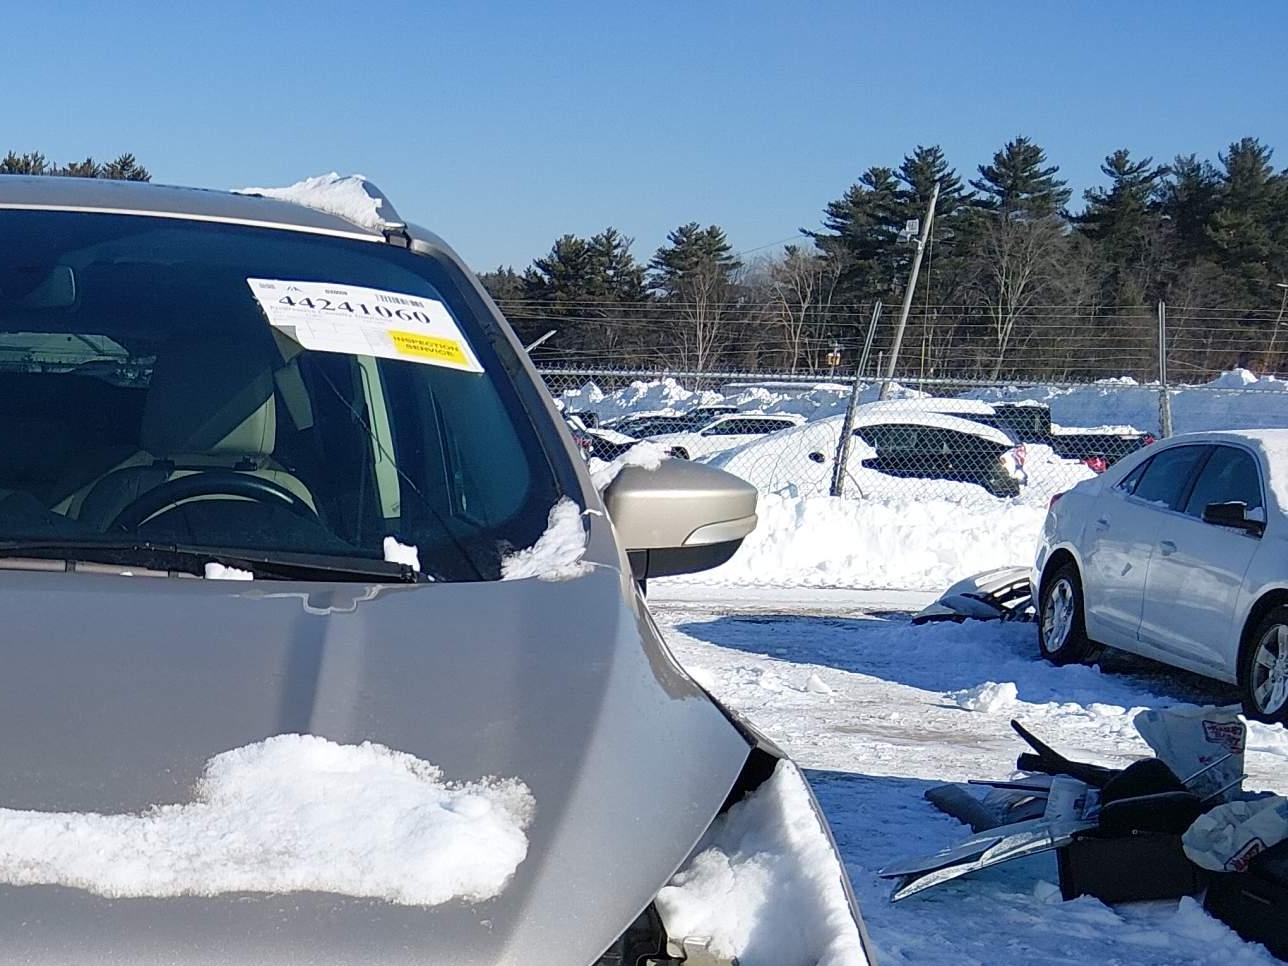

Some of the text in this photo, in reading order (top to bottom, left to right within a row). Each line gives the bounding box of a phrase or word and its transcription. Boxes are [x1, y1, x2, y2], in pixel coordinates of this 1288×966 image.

[278, 295, 432, 324] 44241060
[392, 335, 460, 352] INSPECTION
[405, 343, 455, 357] SERVICE
